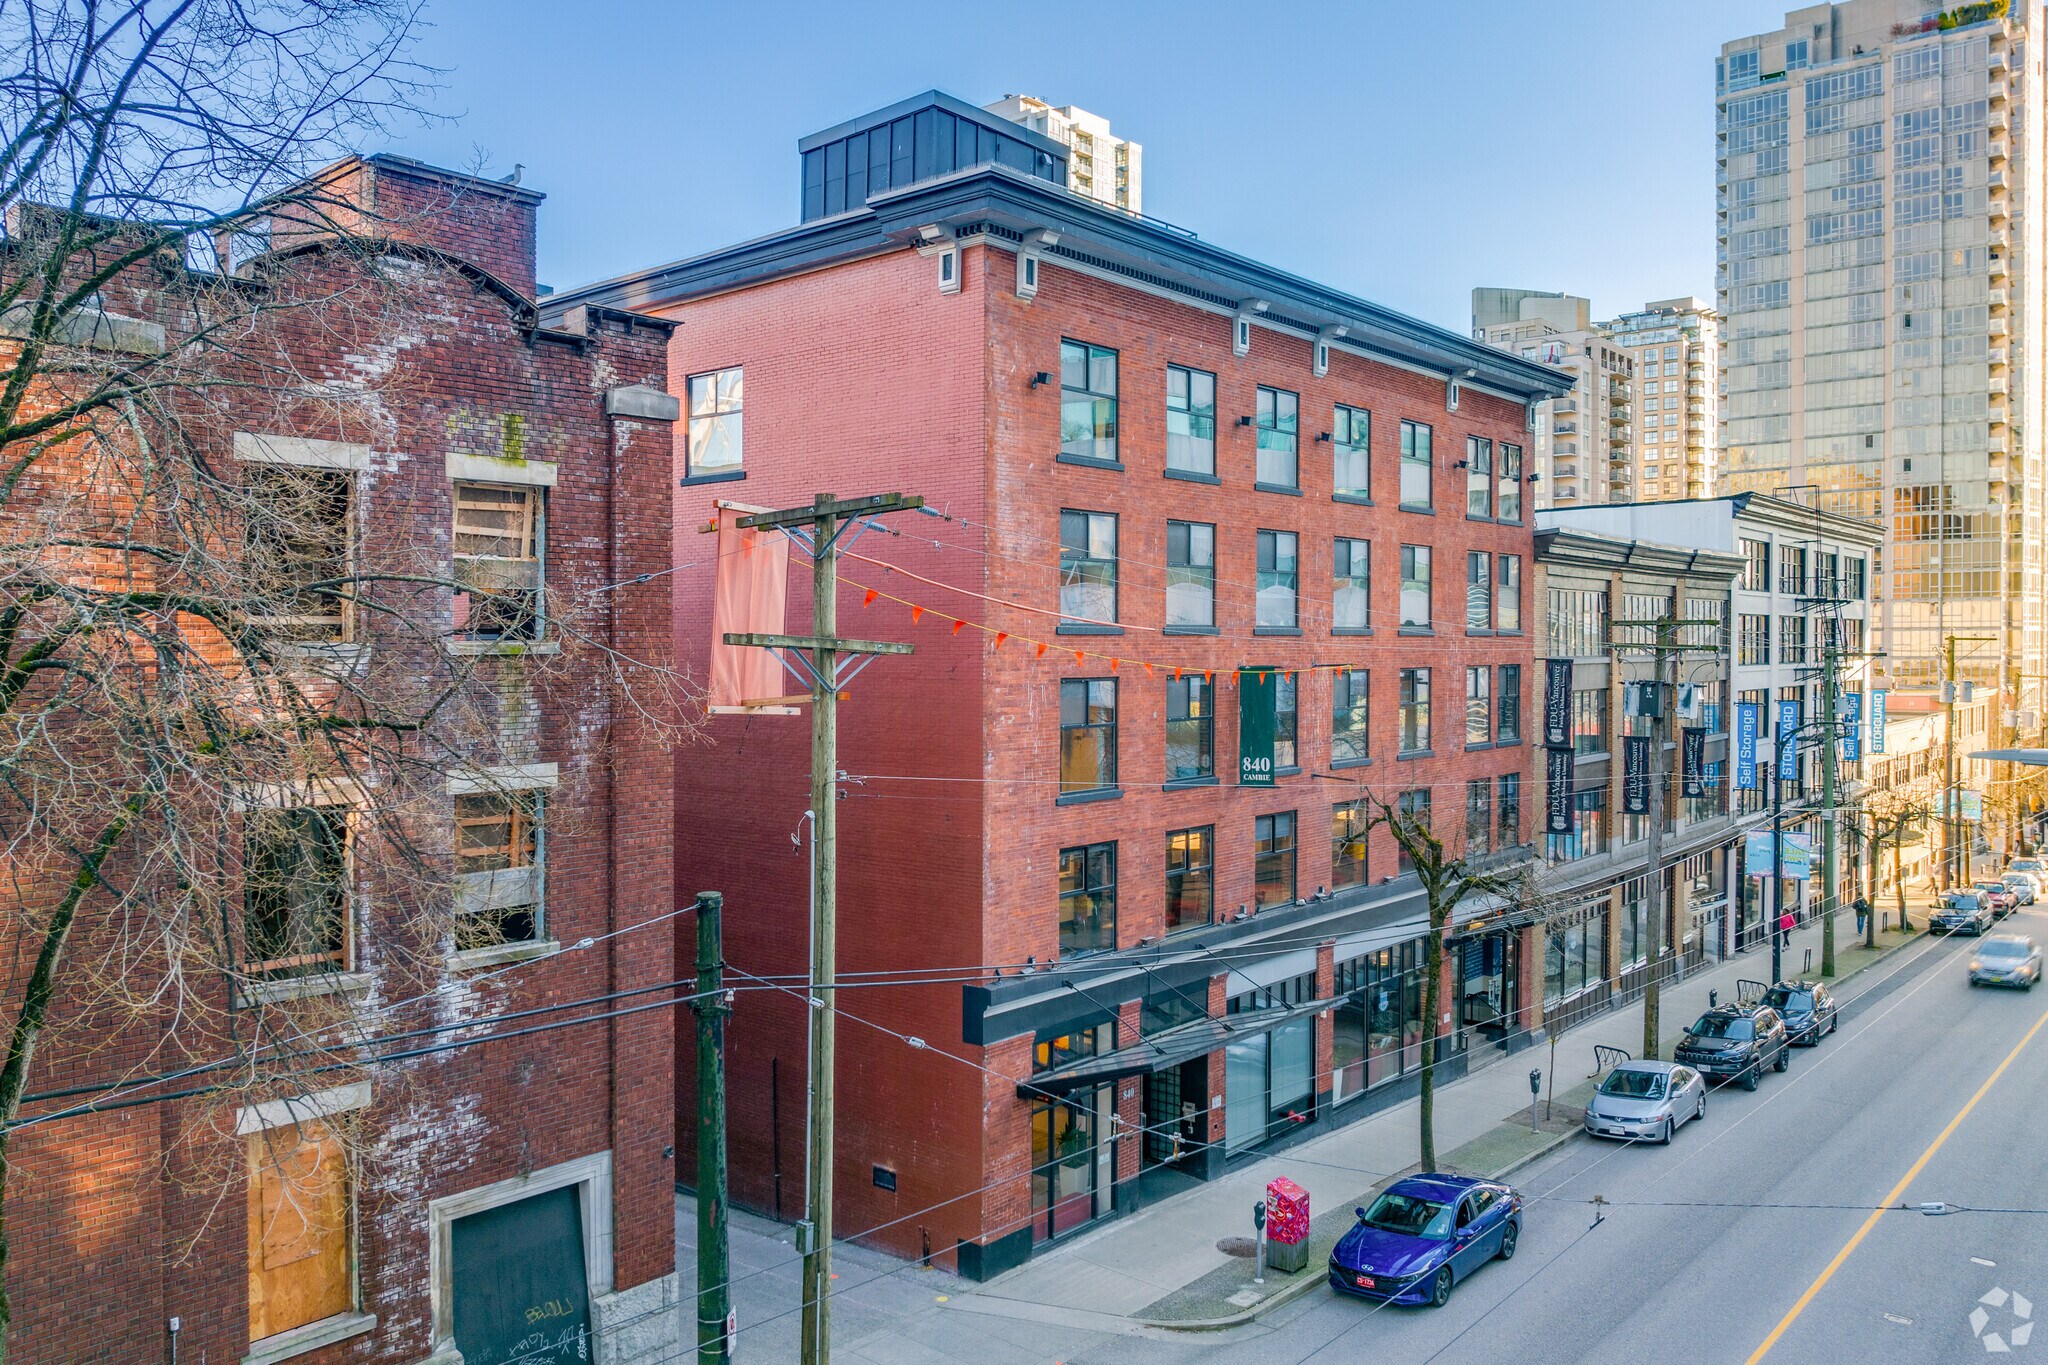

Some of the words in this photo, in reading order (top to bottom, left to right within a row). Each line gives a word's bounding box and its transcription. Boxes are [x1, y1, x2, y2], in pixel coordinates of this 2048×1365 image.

[1550, 665, 1560, 727] FDU-Vancouver
[1740, 710, 1754, 758] Storage
[1873, 694, 1882, 750] STORGUARD
[1243, 757, 1270, 771] 840
[1845, 738, 1854, 757] Self
[1552, 754, 1561, 815] FDU-Vancouver
[1740, 761, 1751, 784] Self
